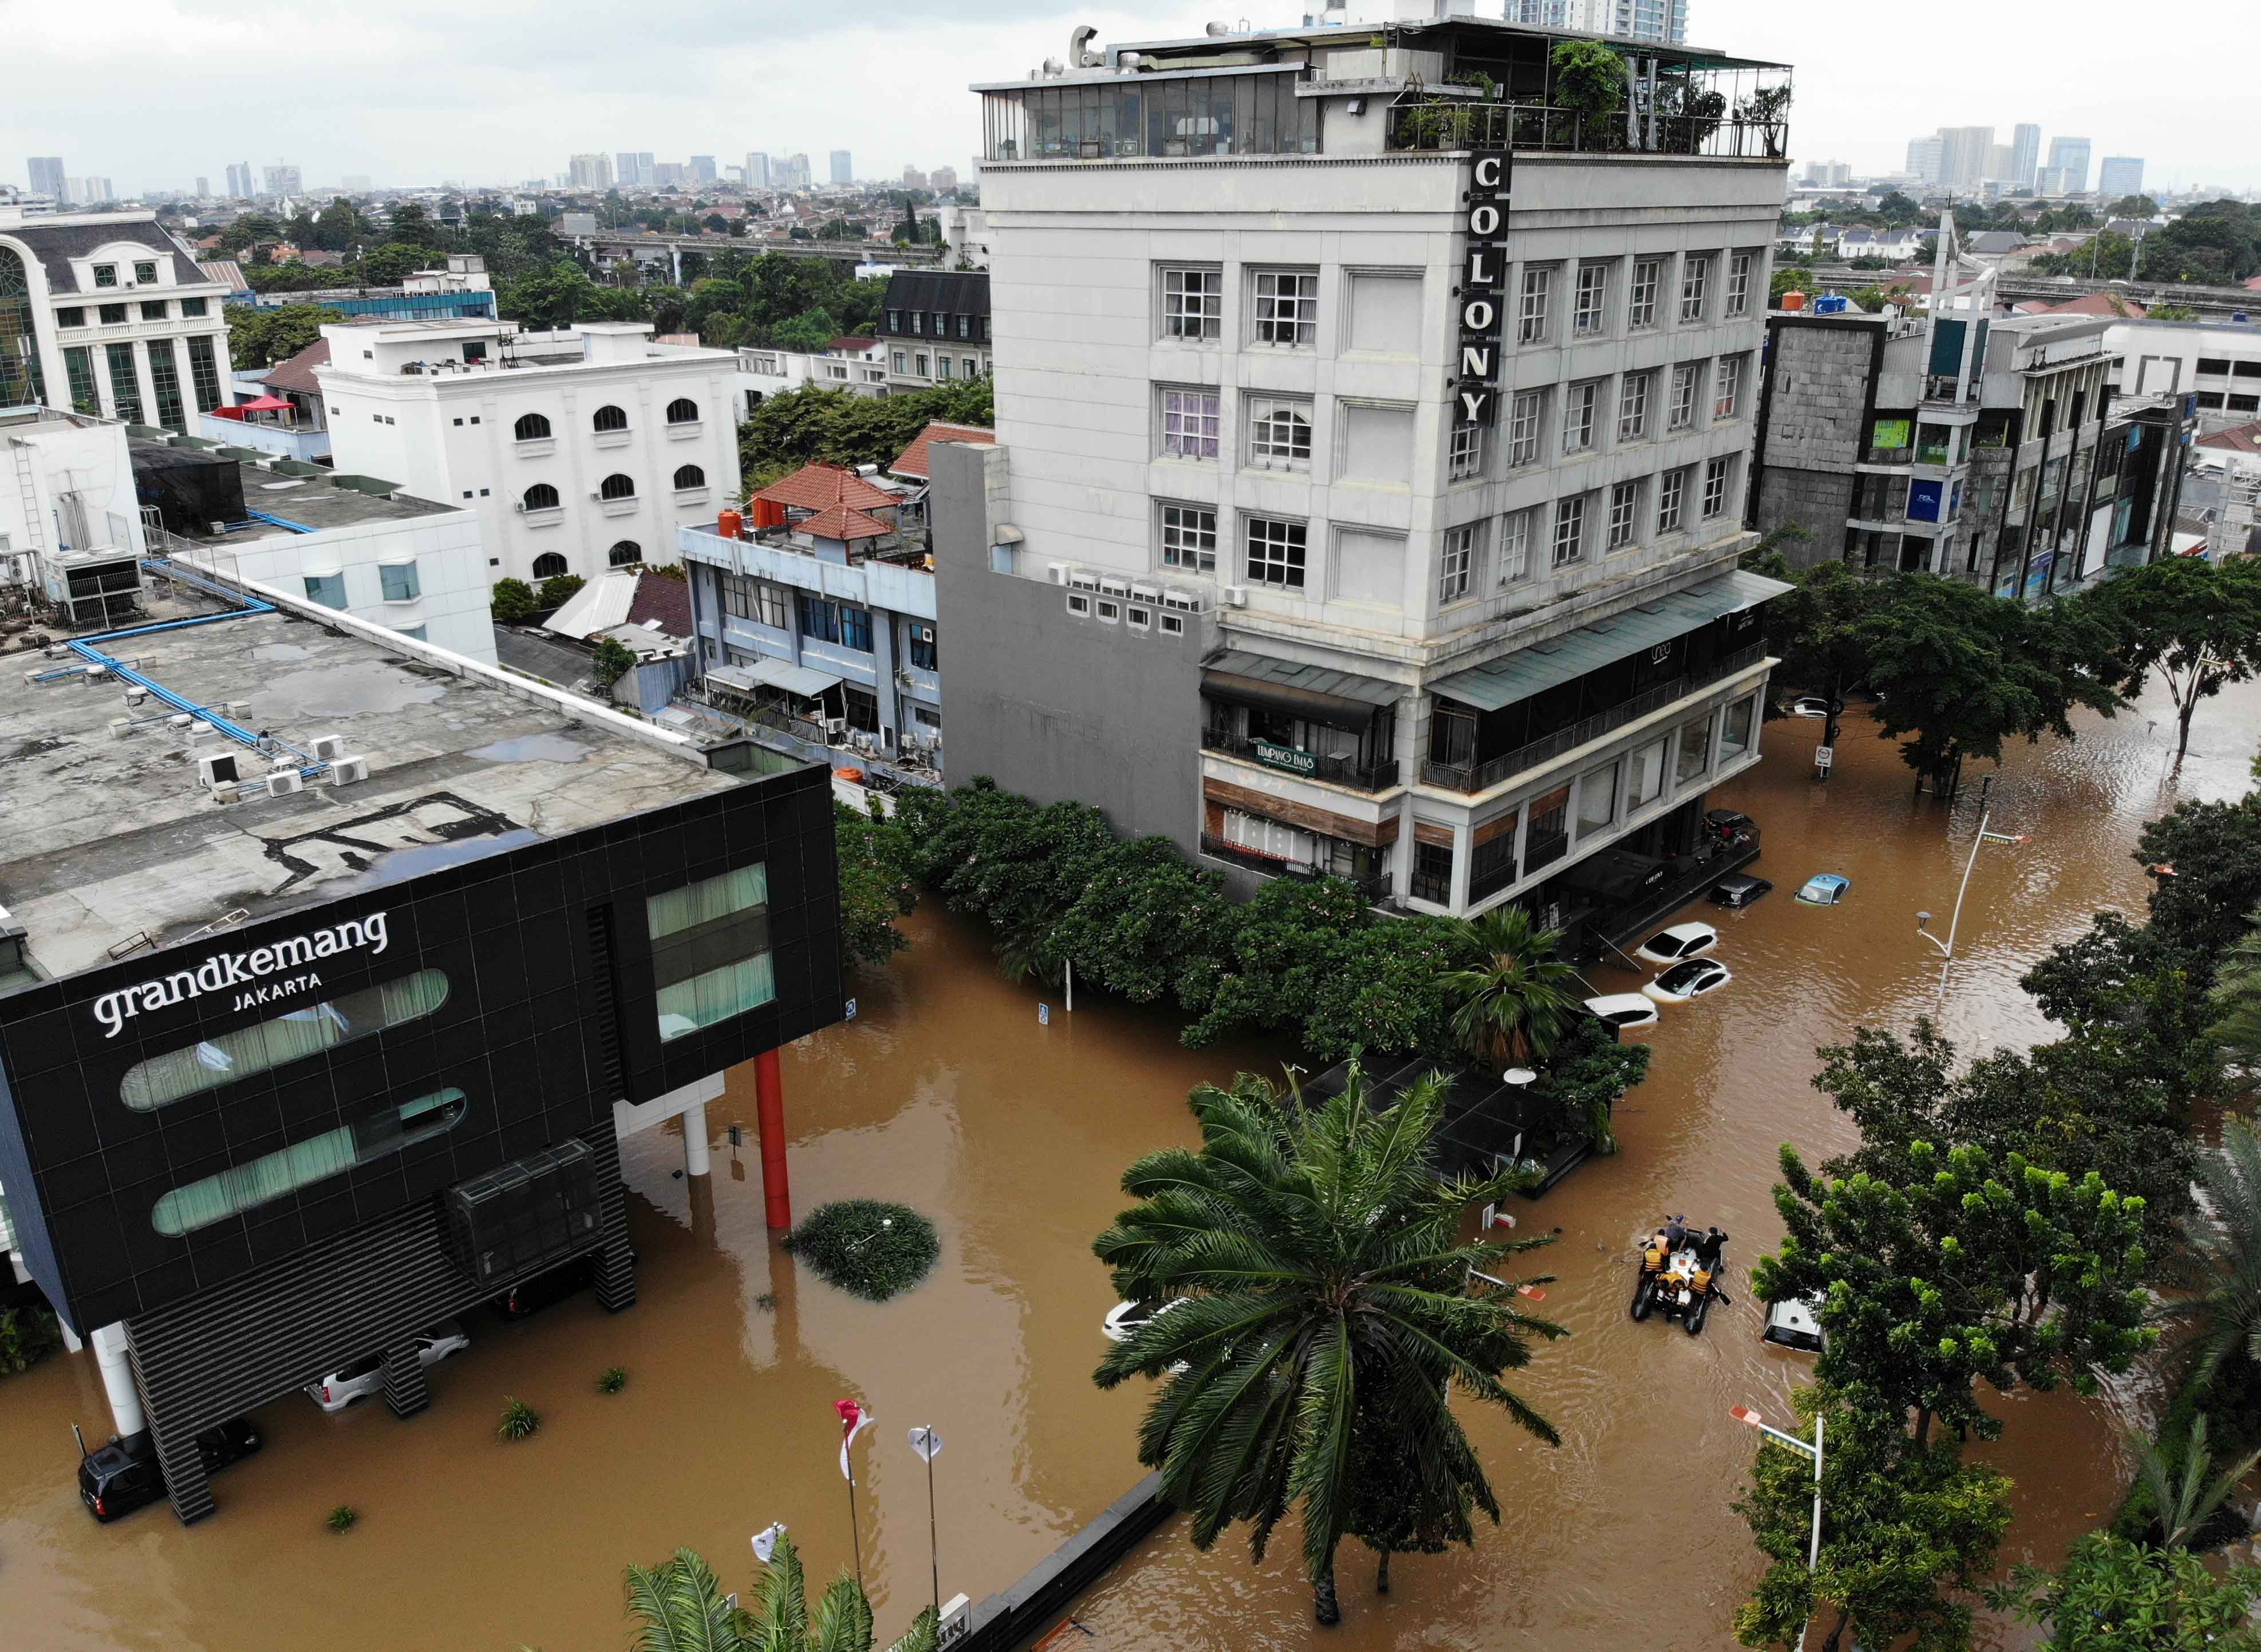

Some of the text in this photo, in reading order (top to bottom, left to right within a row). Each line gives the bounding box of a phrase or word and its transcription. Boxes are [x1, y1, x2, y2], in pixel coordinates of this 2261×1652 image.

[1461, 158, 1501, 421] COLONY
[93, 912, 388, 1039] grandkemang
[234, 973, 322, 1012] JAKARTA
